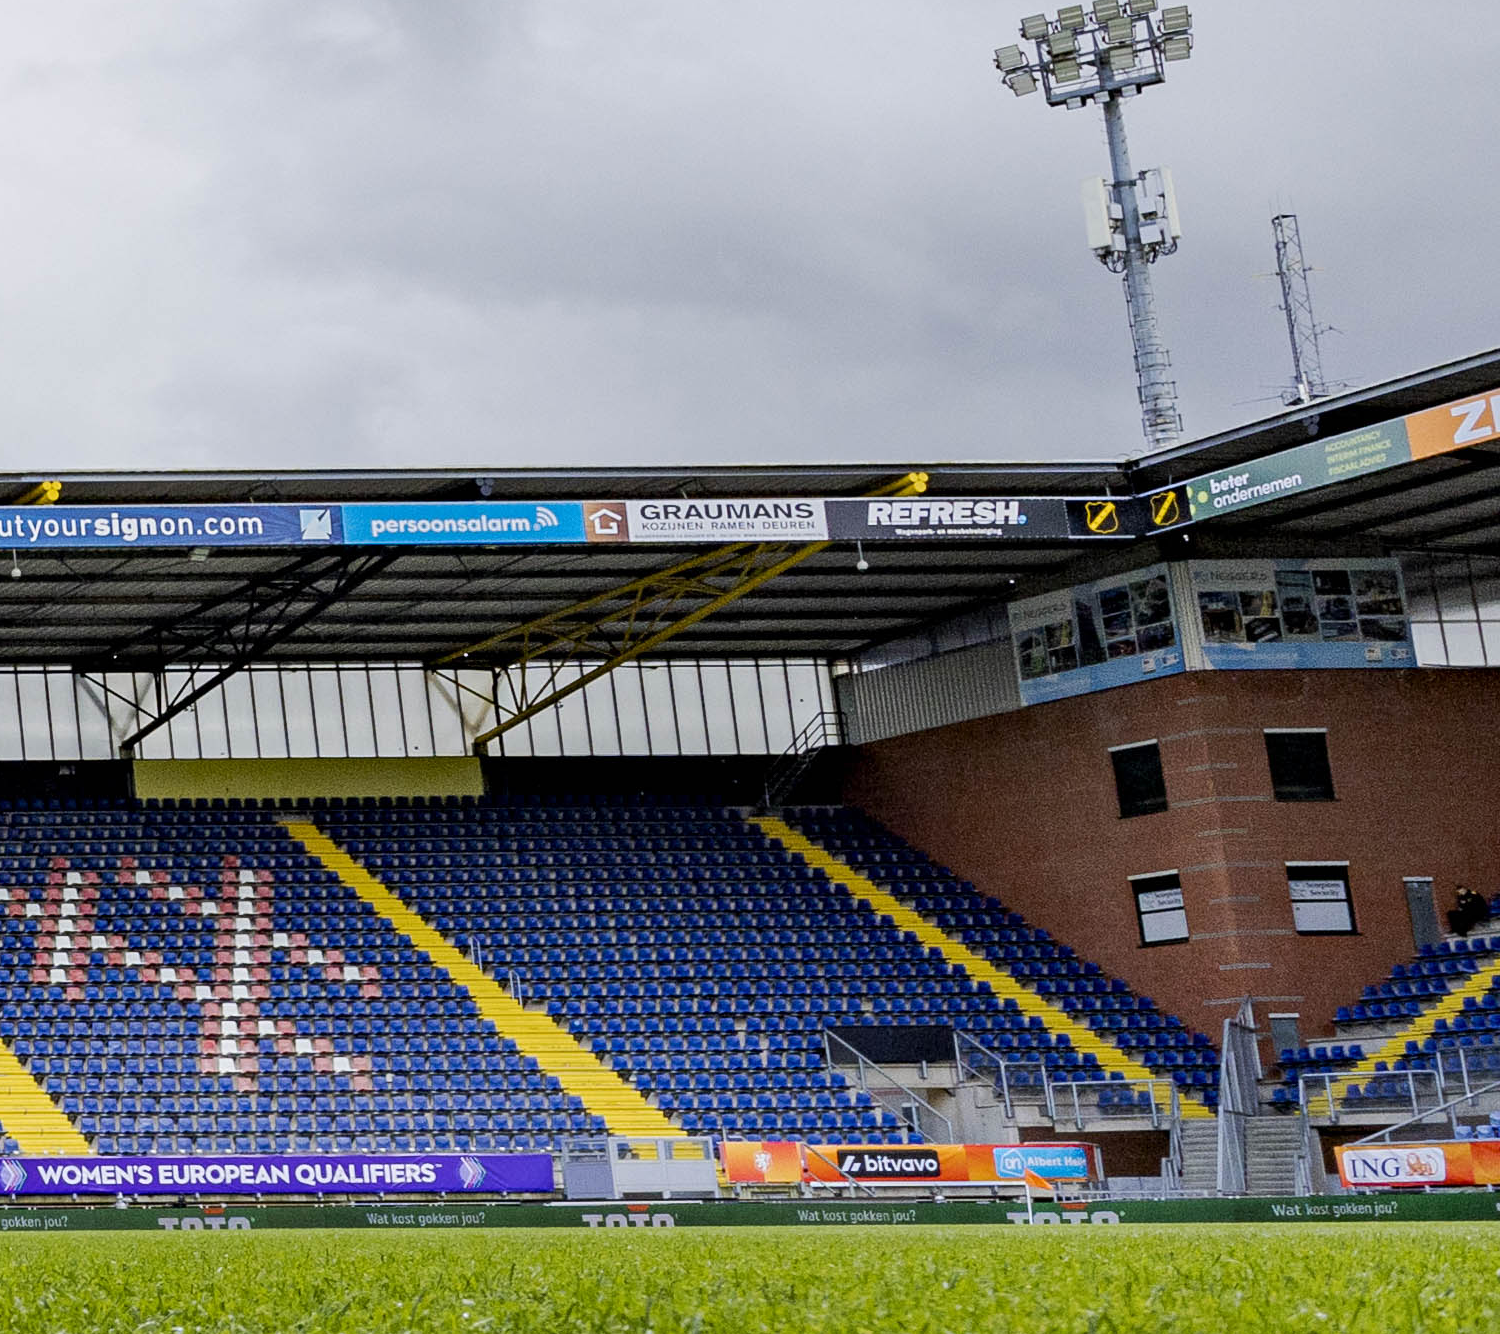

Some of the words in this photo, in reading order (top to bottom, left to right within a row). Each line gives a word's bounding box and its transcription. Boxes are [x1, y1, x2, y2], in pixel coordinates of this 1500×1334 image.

[1210, 471, 1250, 494] beter
[1213, 473, 1302, 509] ondernemen
[640, 503, 815, 521] GRAUMANS
[371, 514, 531, 537] persoonsalarm
[642, 521, 704, 531] KOZIJNEN
[711, 521, 755, 530] RAMEN
[763, 520, 816, 530] DEUREN
[864, 1154, 938, 1173] bitvavo
[1027, 1155, 1062, 1167] Albert
[1351, 1157, 1401, 1179] ING
[38, 1165, 153, 1185] WOMEN'S
[158, 1163, 291, 1185] EUROPEAN
[1272, 1203, 1302, 1216] Wat
[1305, 1204, 1328, 1216] kost
[1333, 1203, 1372, 1218] gokken
[1374, 1201, 1398, 1217] jou?
[367, 1213, 389, 1224] Wat
[392, 1214, 415, 1224] kost
[419, 1213, 459, 1227] gokken
[462, 1212, 486, 1227] jou?
